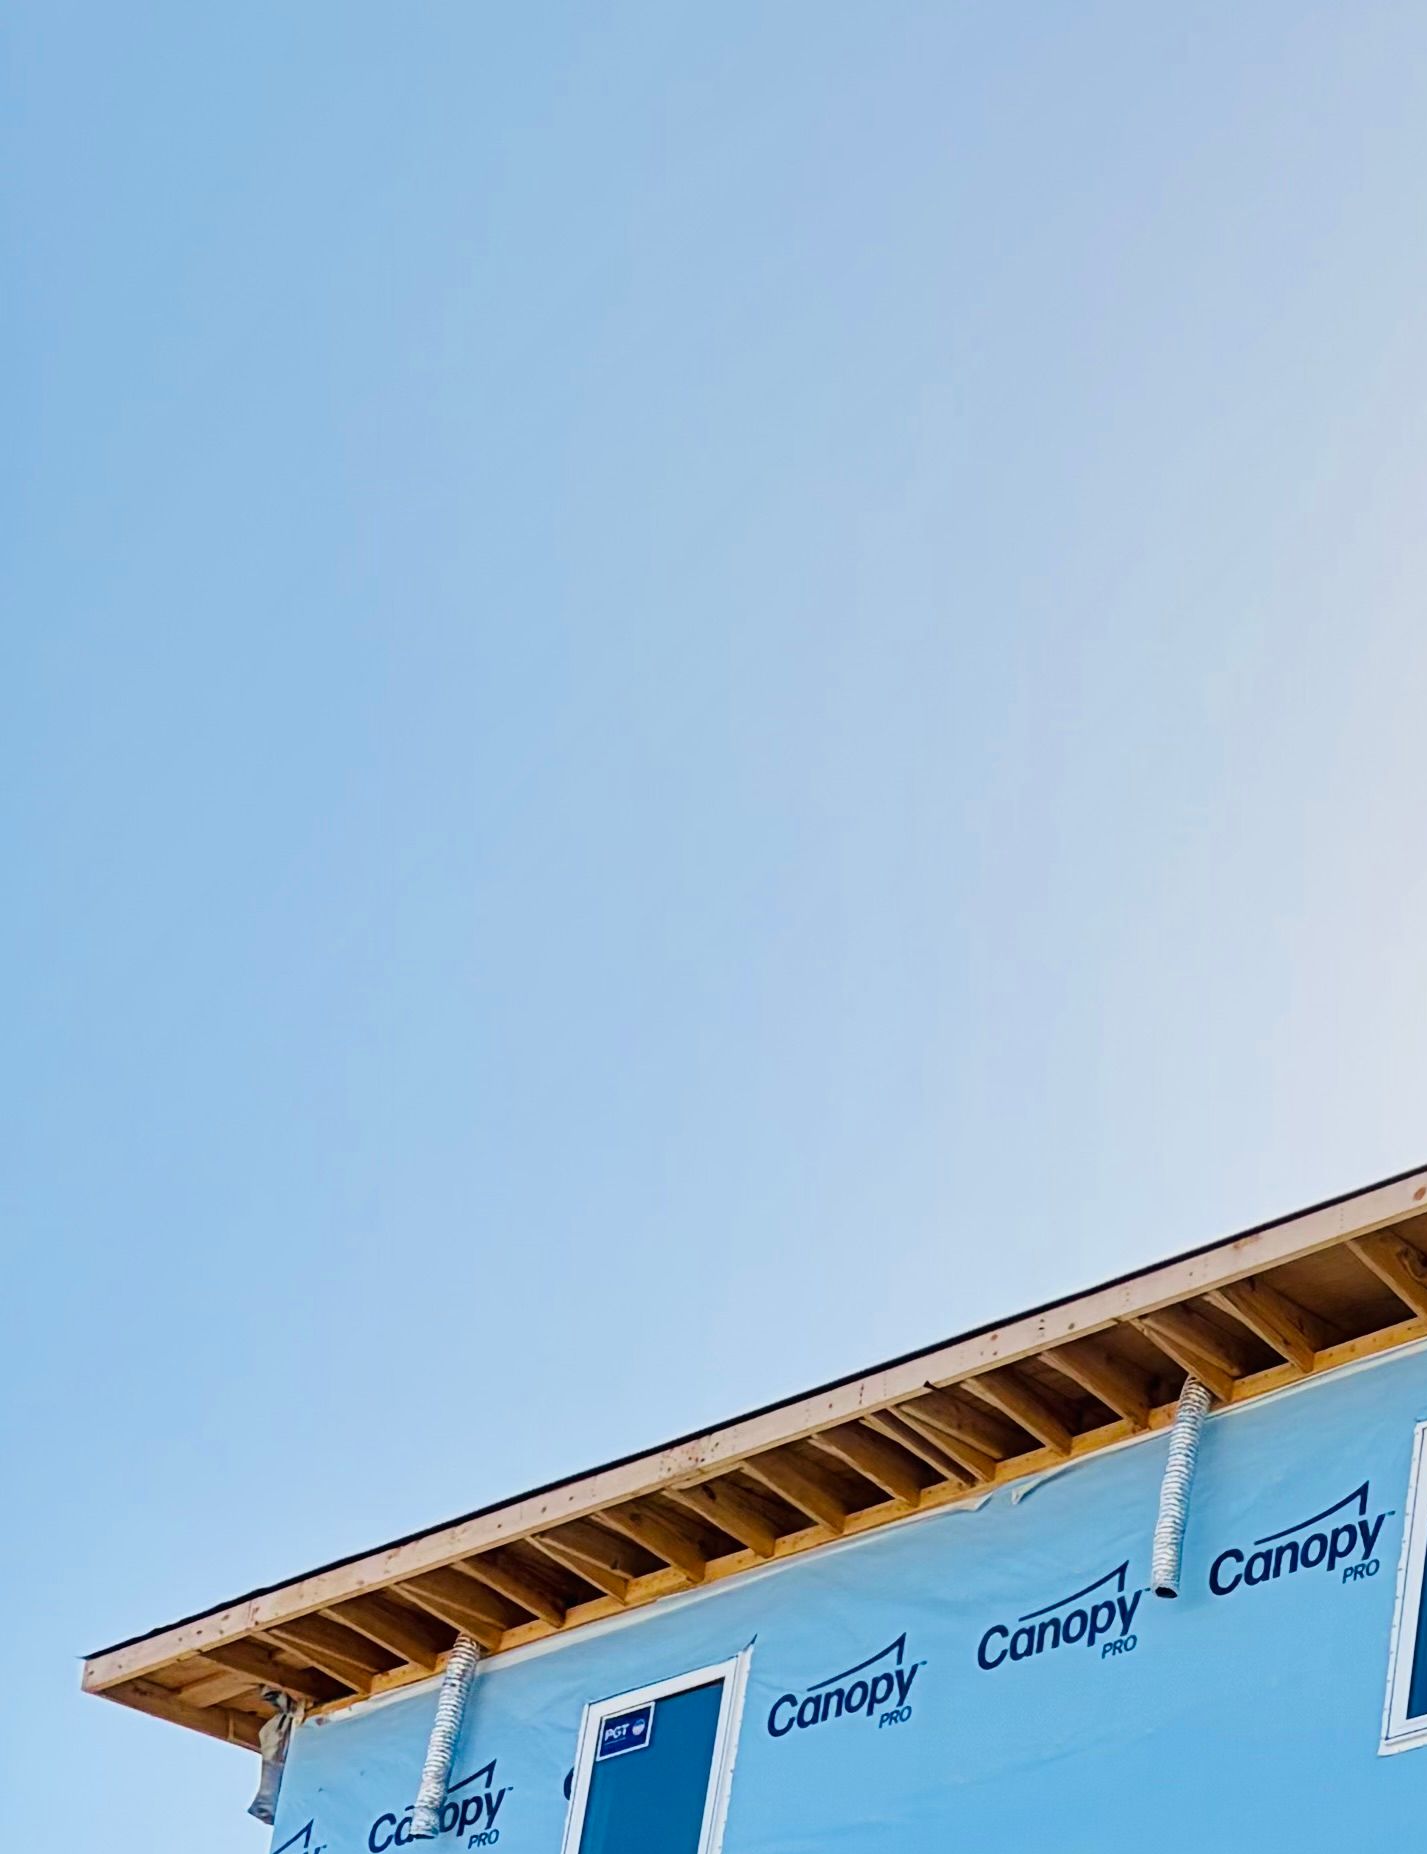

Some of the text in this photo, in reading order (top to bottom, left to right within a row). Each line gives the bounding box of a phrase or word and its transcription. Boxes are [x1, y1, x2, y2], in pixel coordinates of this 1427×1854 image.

[1209, 1514, 1386, 1597] Canopy
[1342, 1558, 1379, 1585] PRO
[977, 1590, 1141, 1671] Canopy
[1102, 1634, 1137, 1660] PRO
[767, 1658, 918, 1741] Canopy
[880, 1704, 912, 1728] PRO
[605, 1724, 628, 1740] PGT
[369, 1788, 506, 1854] Caopy
[468, 1829, 499, 1849] PRO
